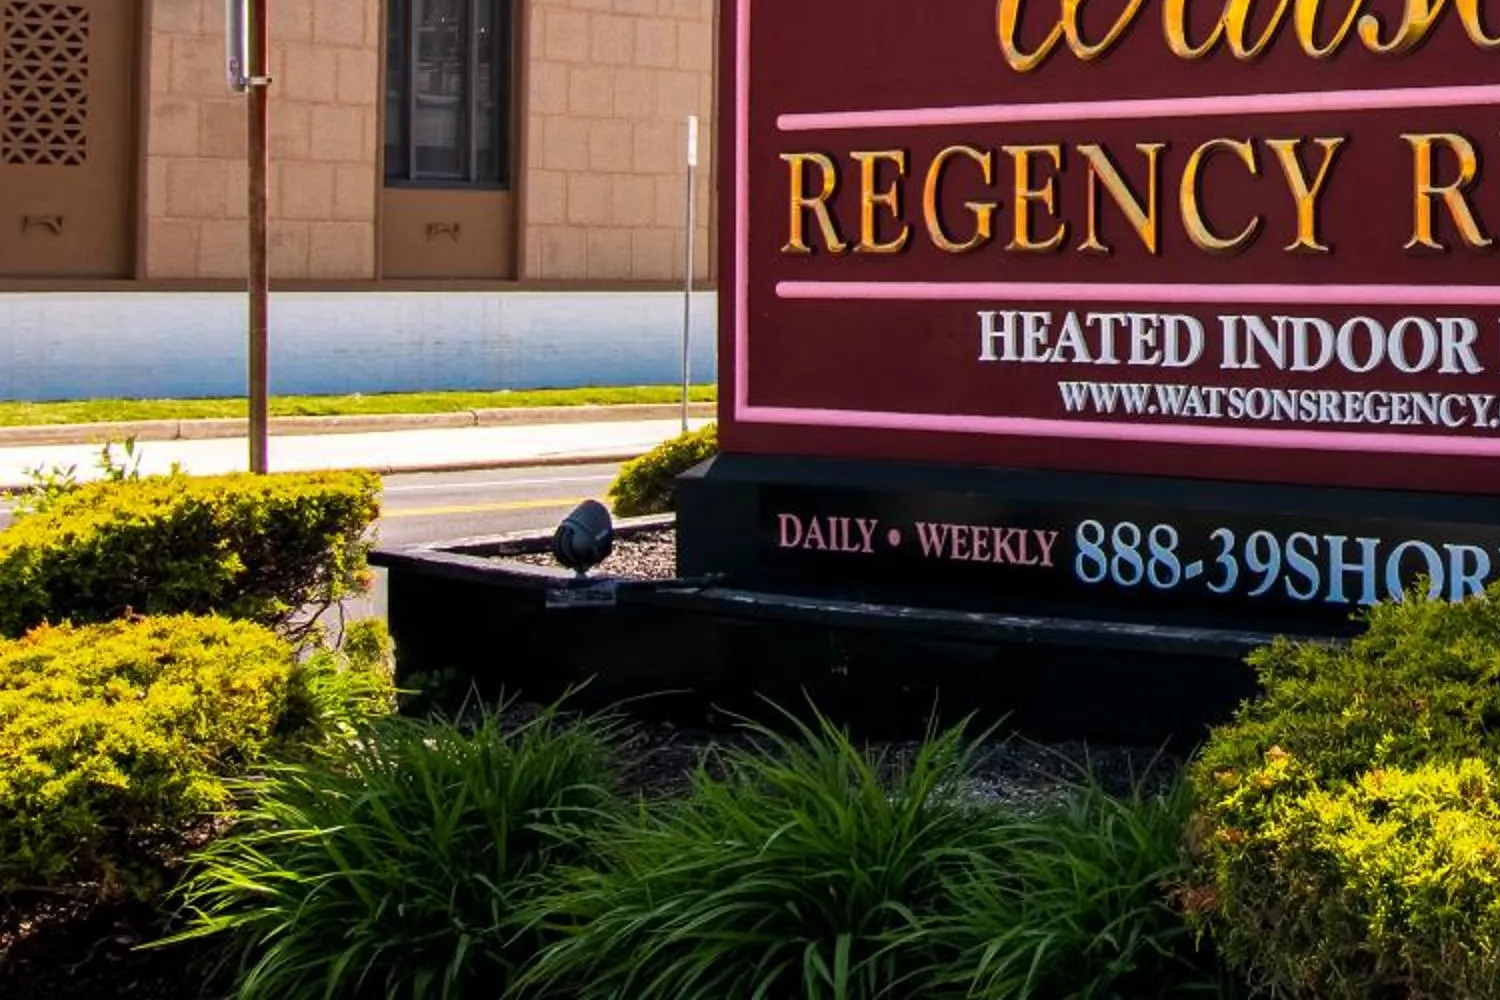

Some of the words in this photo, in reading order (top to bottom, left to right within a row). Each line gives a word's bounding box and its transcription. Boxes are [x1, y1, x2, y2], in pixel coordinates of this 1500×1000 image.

[778, 136, 1347, 256] REGENCY
[977, 310, 1205, 367] HEATED
[1219, 315, 1481, 374] INDOOR
[777, 512, 878, 554] DAILY
[915, 521, 1059, 568] WEEKLY
